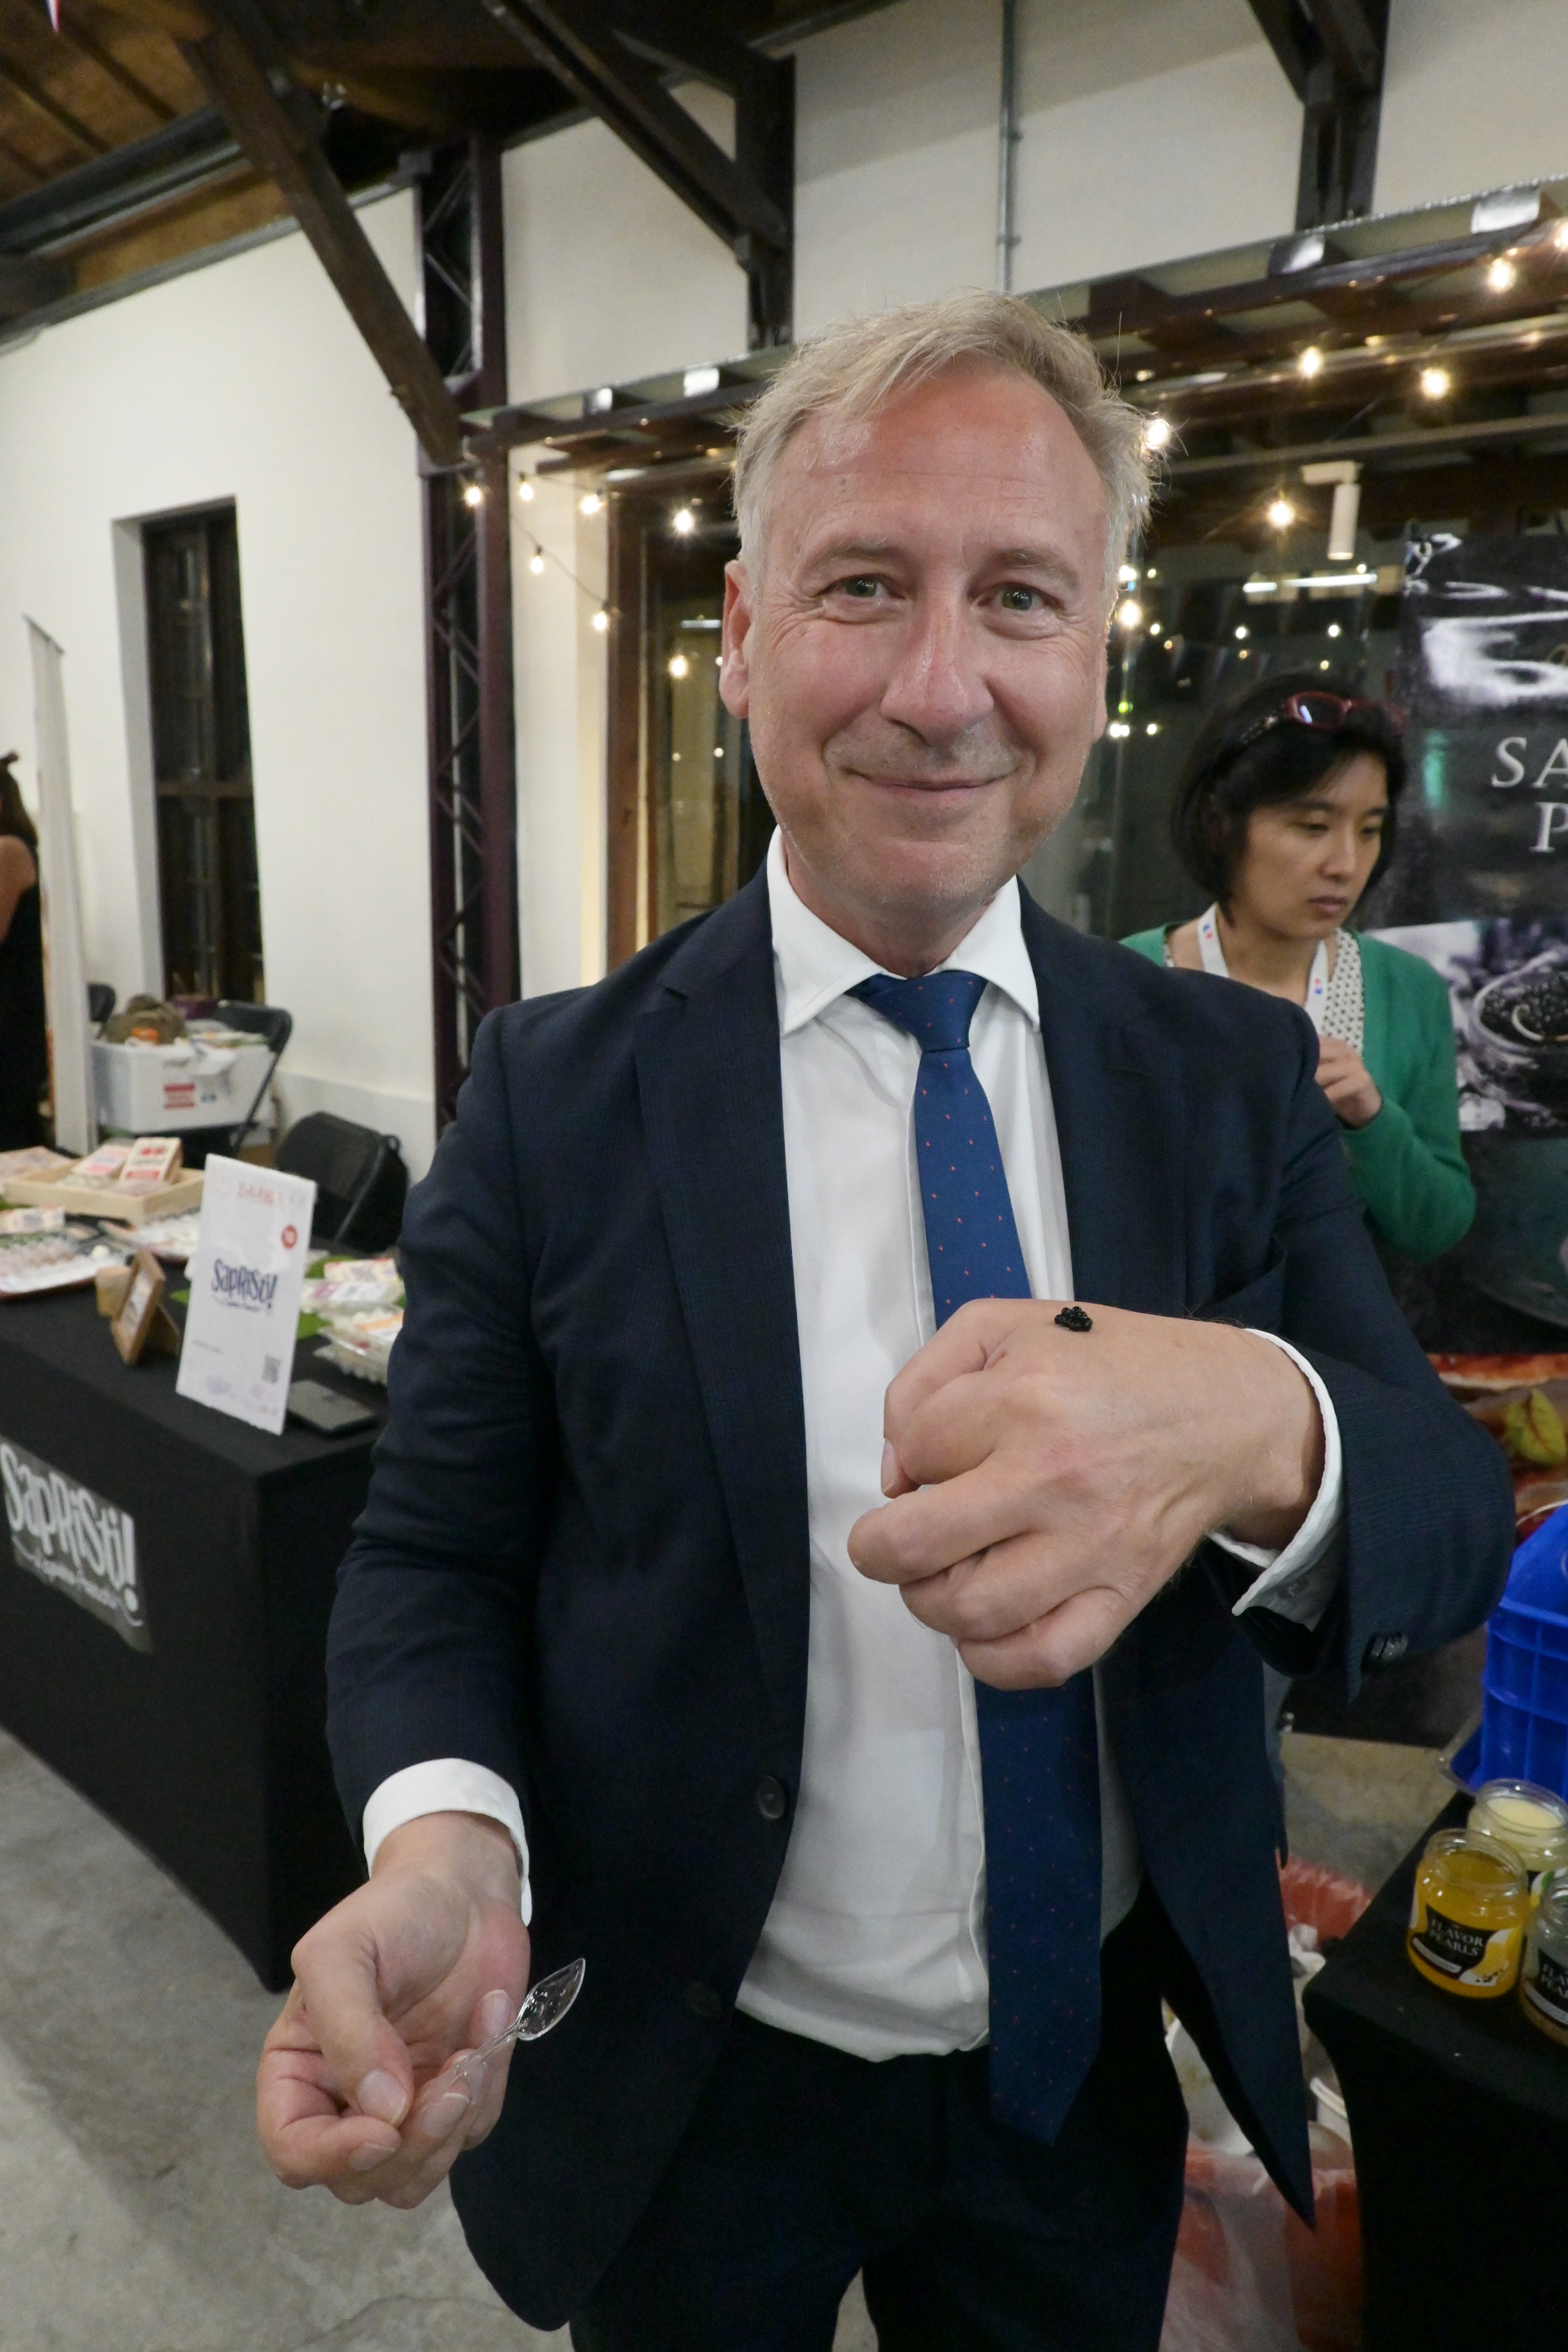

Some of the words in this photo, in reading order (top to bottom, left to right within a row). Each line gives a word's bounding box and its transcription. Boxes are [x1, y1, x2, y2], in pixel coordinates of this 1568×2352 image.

[1491, 736, 1568, 789] SA
[1429, 1929, 1479, 1956] PEARLS
[1431, 1919, 1483, 1947] FLAVOR
